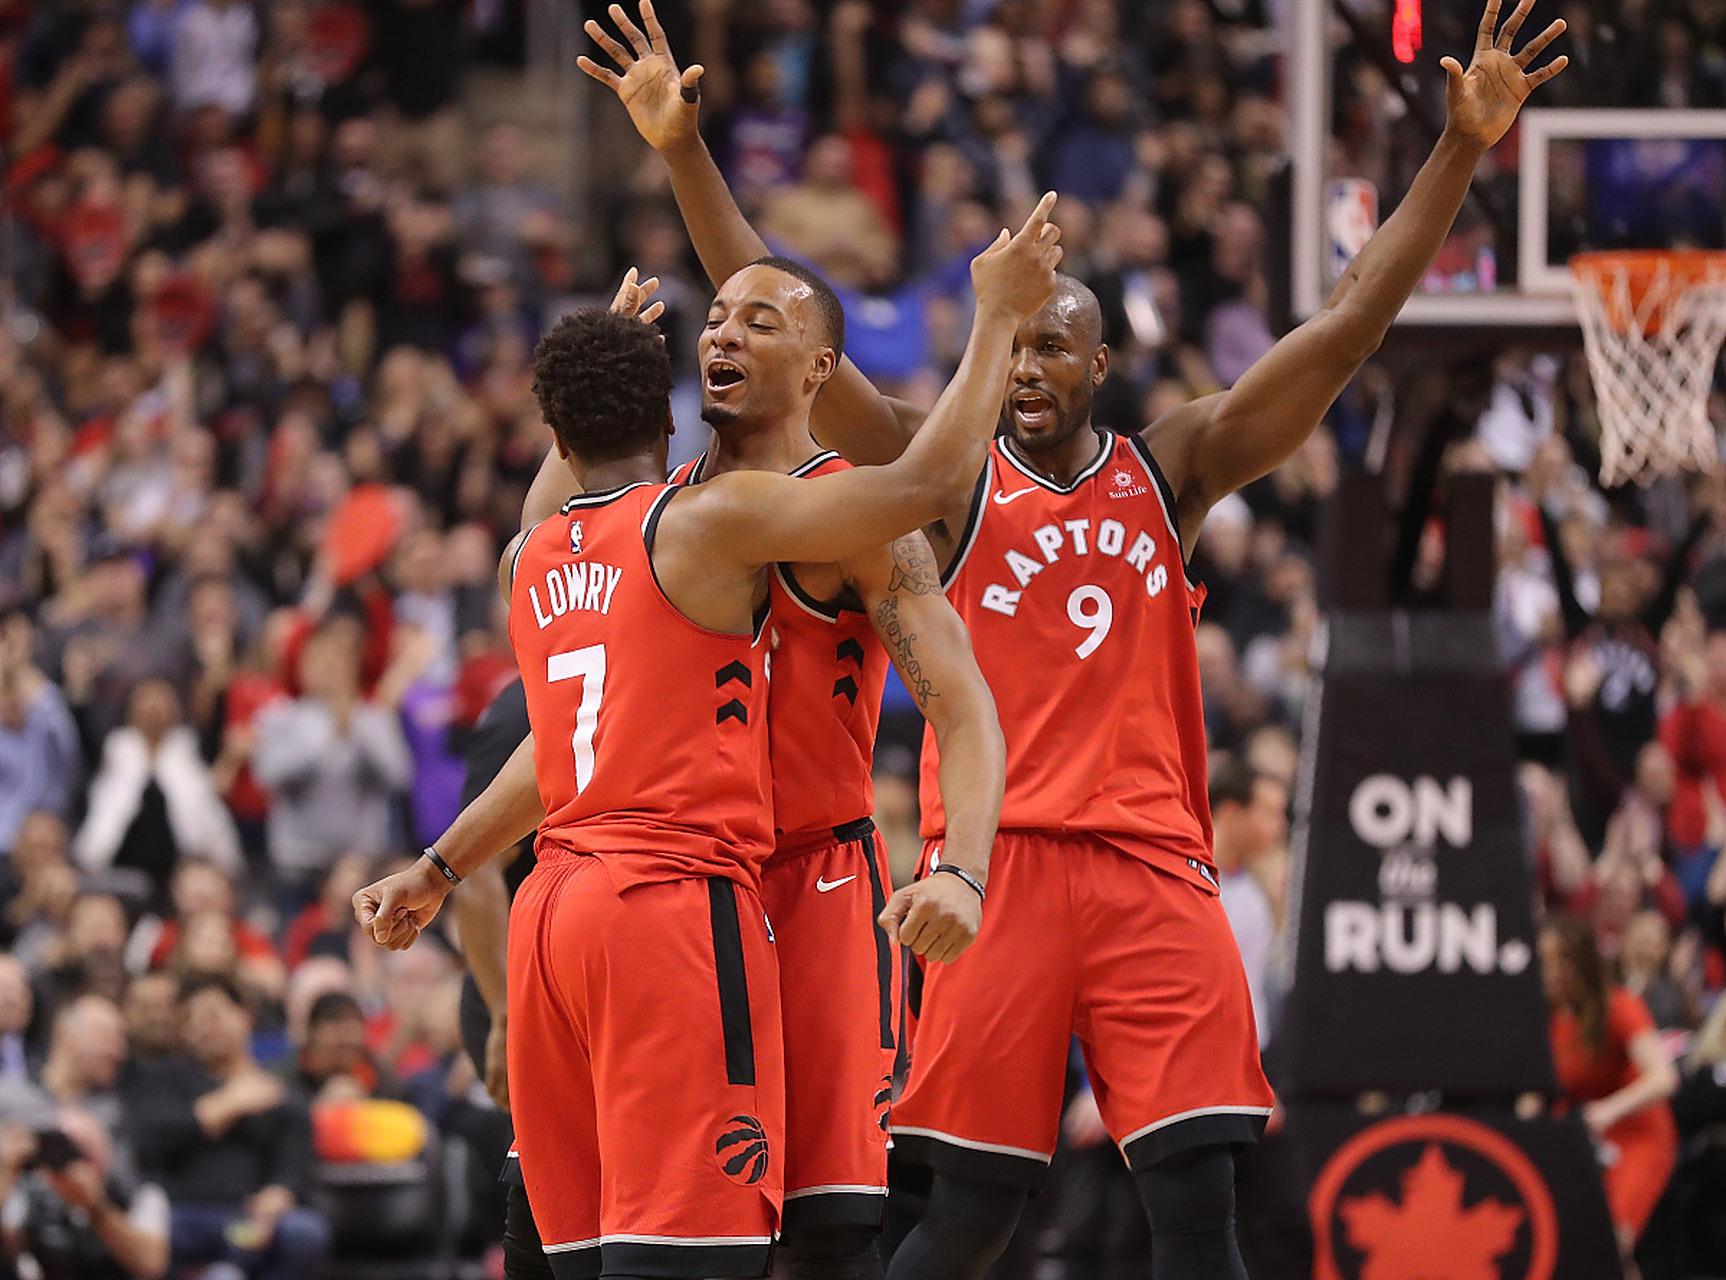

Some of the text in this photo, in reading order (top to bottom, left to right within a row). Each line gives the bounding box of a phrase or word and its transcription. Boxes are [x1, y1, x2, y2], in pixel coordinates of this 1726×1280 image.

[1109, 484, 1147, 499] Sun Life
[528, 560, 623, 630] LOWRY
[980, 518, 1169, 618] RAPTORS
[1066, 584, 1114, 660] 9
[547, 643, 606, 796] 7
[1349, 773, 1473, 849] ON
[1324, 899, 1531, 975] RUN.
